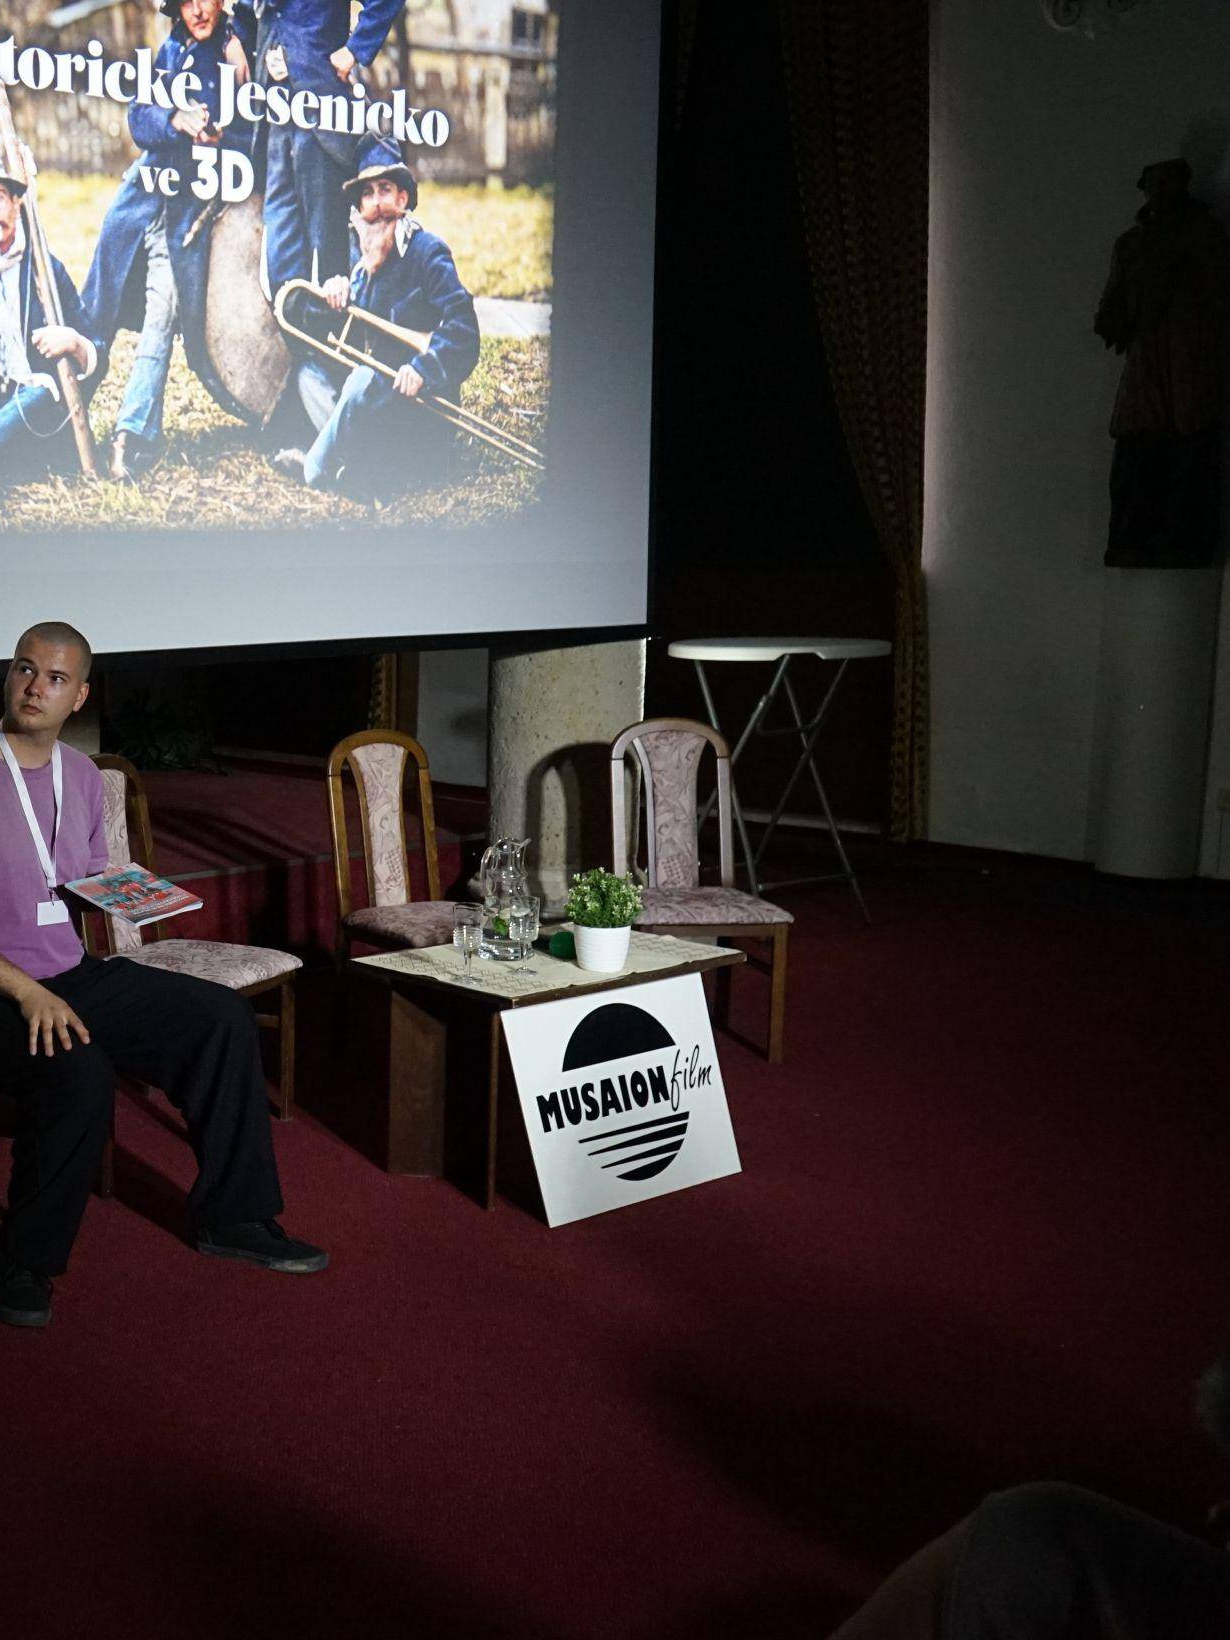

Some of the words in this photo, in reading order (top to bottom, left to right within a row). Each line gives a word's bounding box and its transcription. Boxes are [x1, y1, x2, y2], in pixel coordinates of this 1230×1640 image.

[213, 62, 450, 148] Jesenicko
[139, 165, 181, 196] ve
[190, 145, 255, 203] 3D
[536, 1065, 670, 1133] MUSAION
[670, 1044, 712, 1112] film
